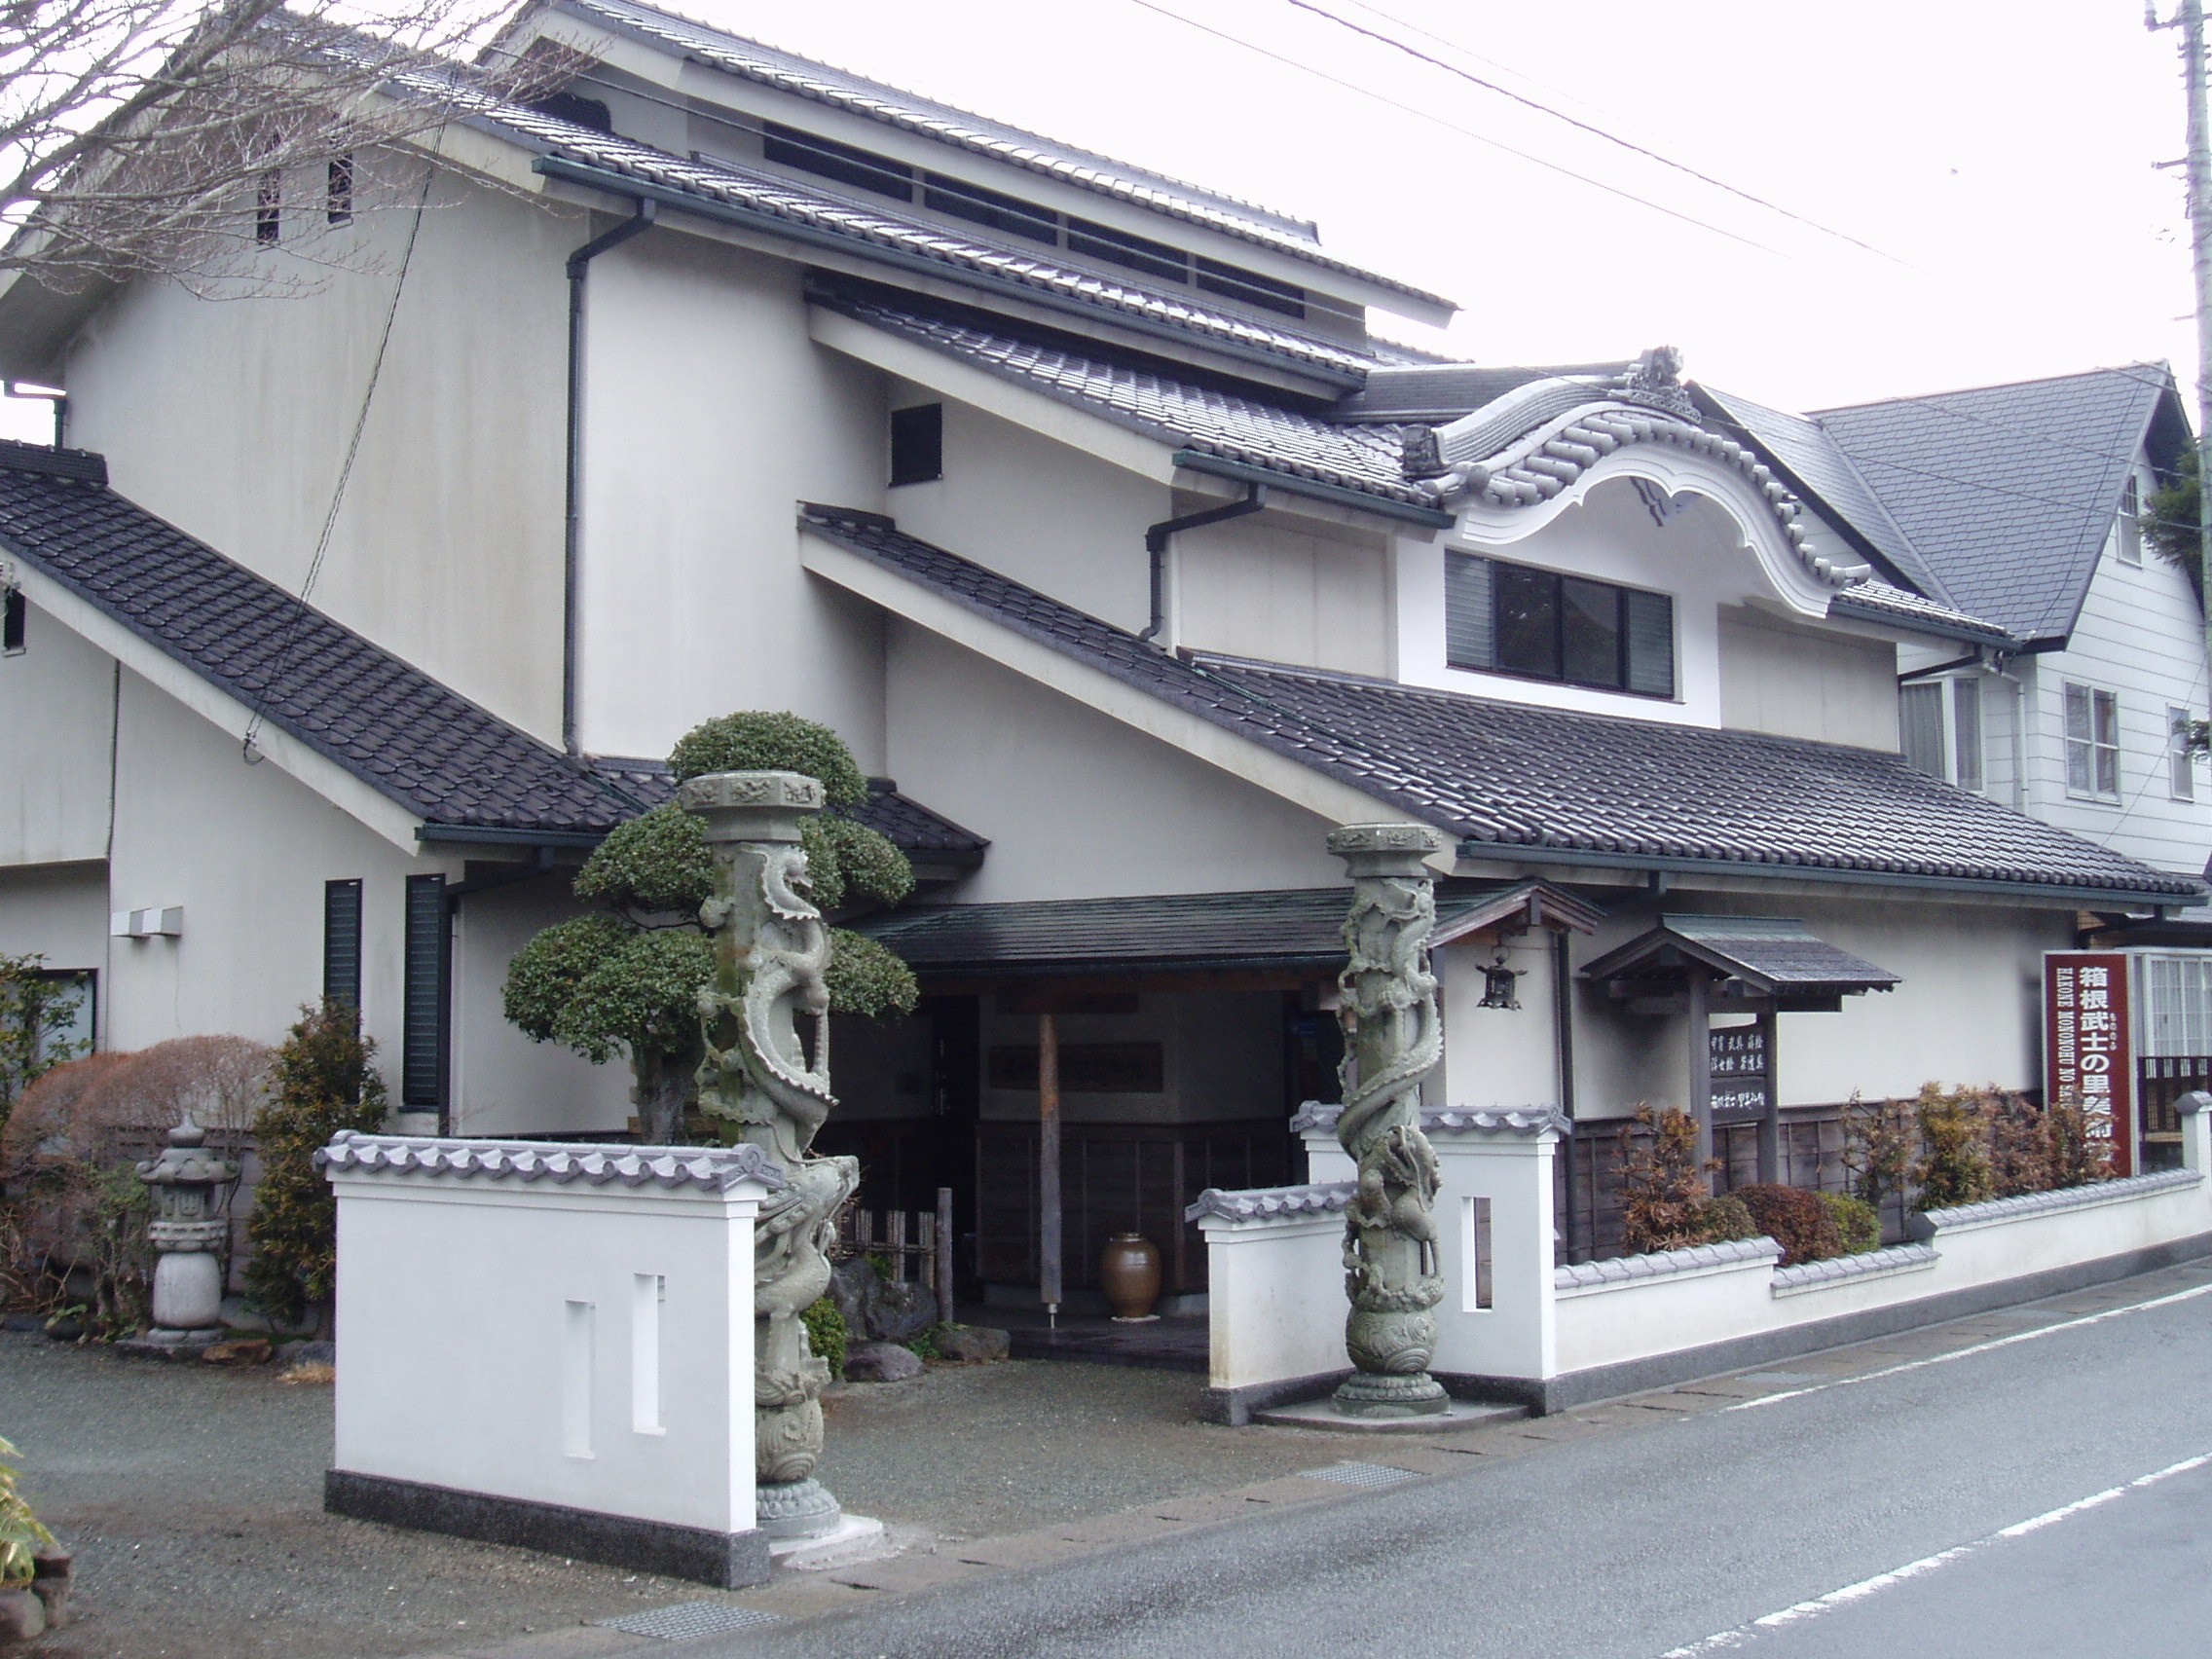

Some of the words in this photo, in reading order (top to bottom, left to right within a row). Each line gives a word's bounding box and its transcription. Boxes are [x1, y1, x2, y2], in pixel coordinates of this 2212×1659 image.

[2056, 967, 2074, 1008] HAKONE
[2057, 1011, 2076, 1065] MONONOHU
[2058, 1067, 2076, 1082] NO
